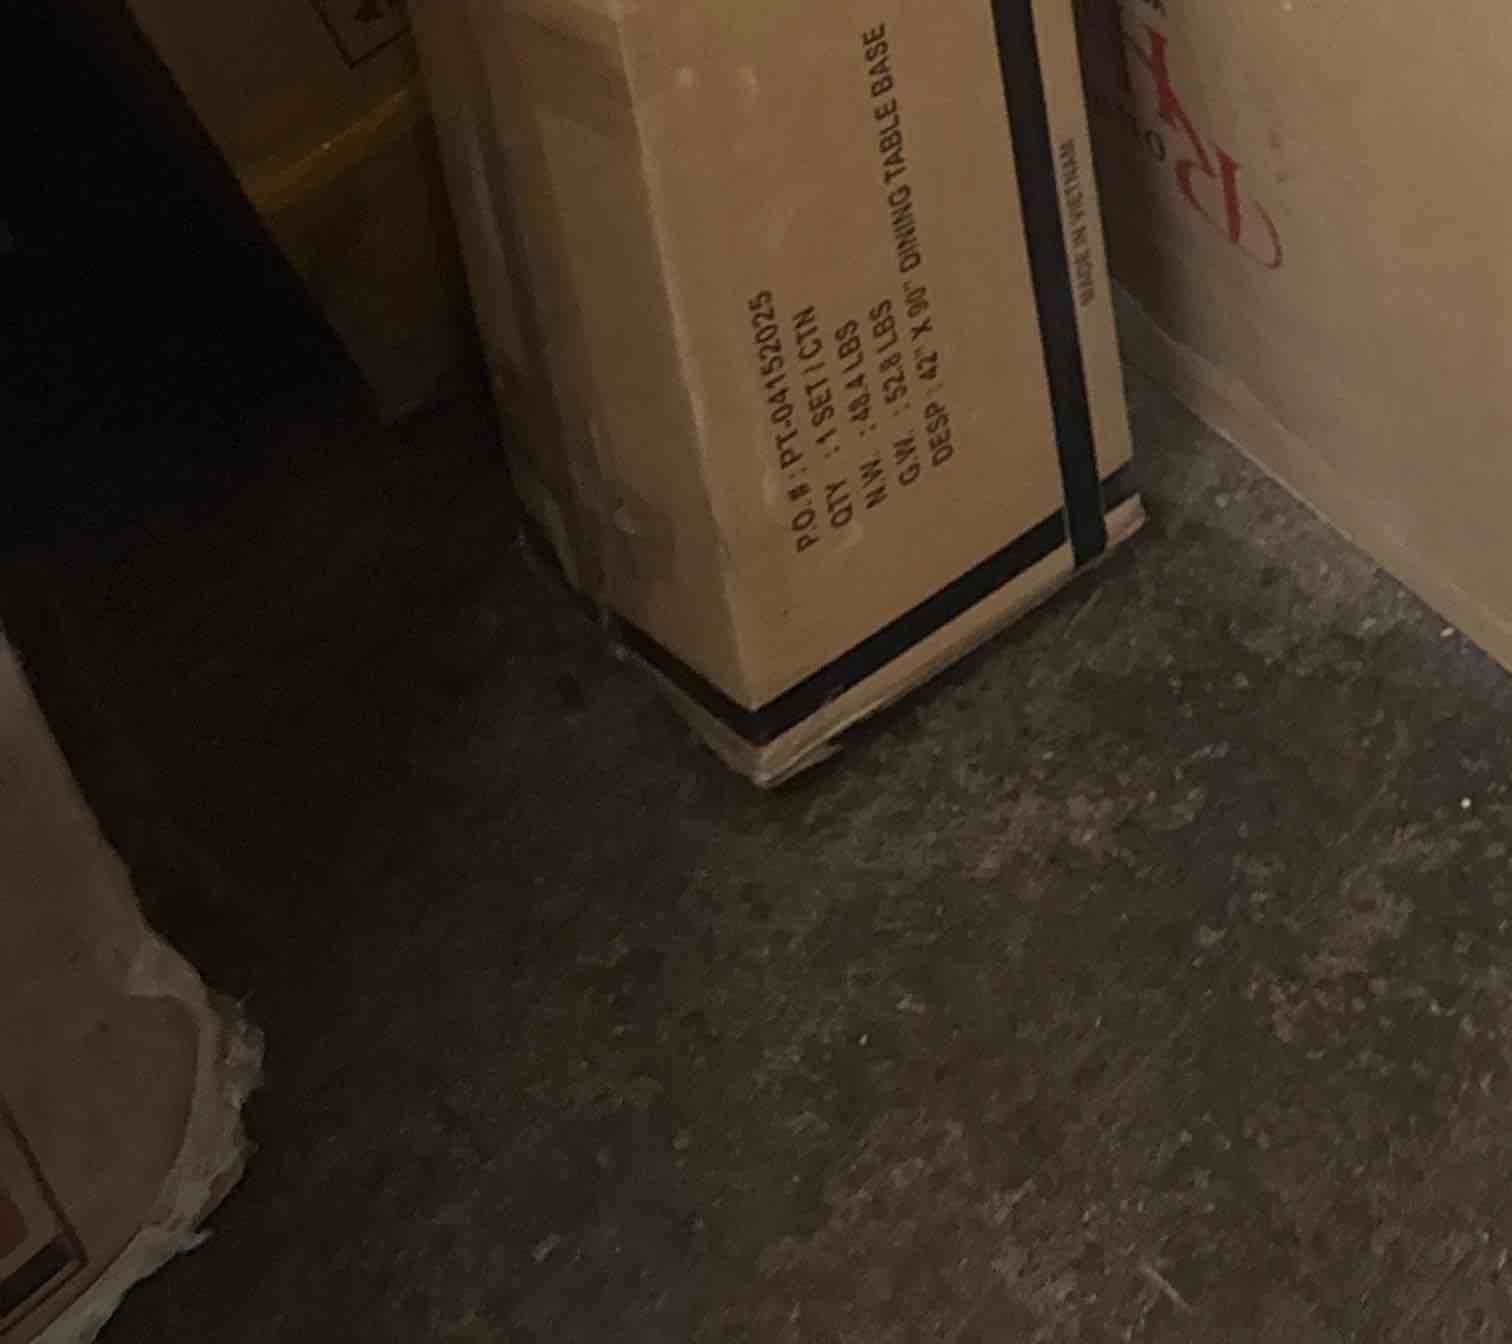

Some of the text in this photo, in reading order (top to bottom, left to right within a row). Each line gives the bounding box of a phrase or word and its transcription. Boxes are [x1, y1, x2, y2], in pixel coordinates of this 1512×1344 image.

[862, 22, 895, 97] BASE
[874, 97, 911, 185] TABLE
[888, 184, 921, 274] DINING
[792, 305, 823, 361] CTN
[834, 319, 864, 374] LBS
[869, 298, 898, 354] LBS
[910, 316, 933, 342] X
[749, 290, 804, 471] PT-04152025
[804, 377, 835, 427] SET
[924, 400, 954, 467] DESP
[825, 478, 854, 528] QTY
